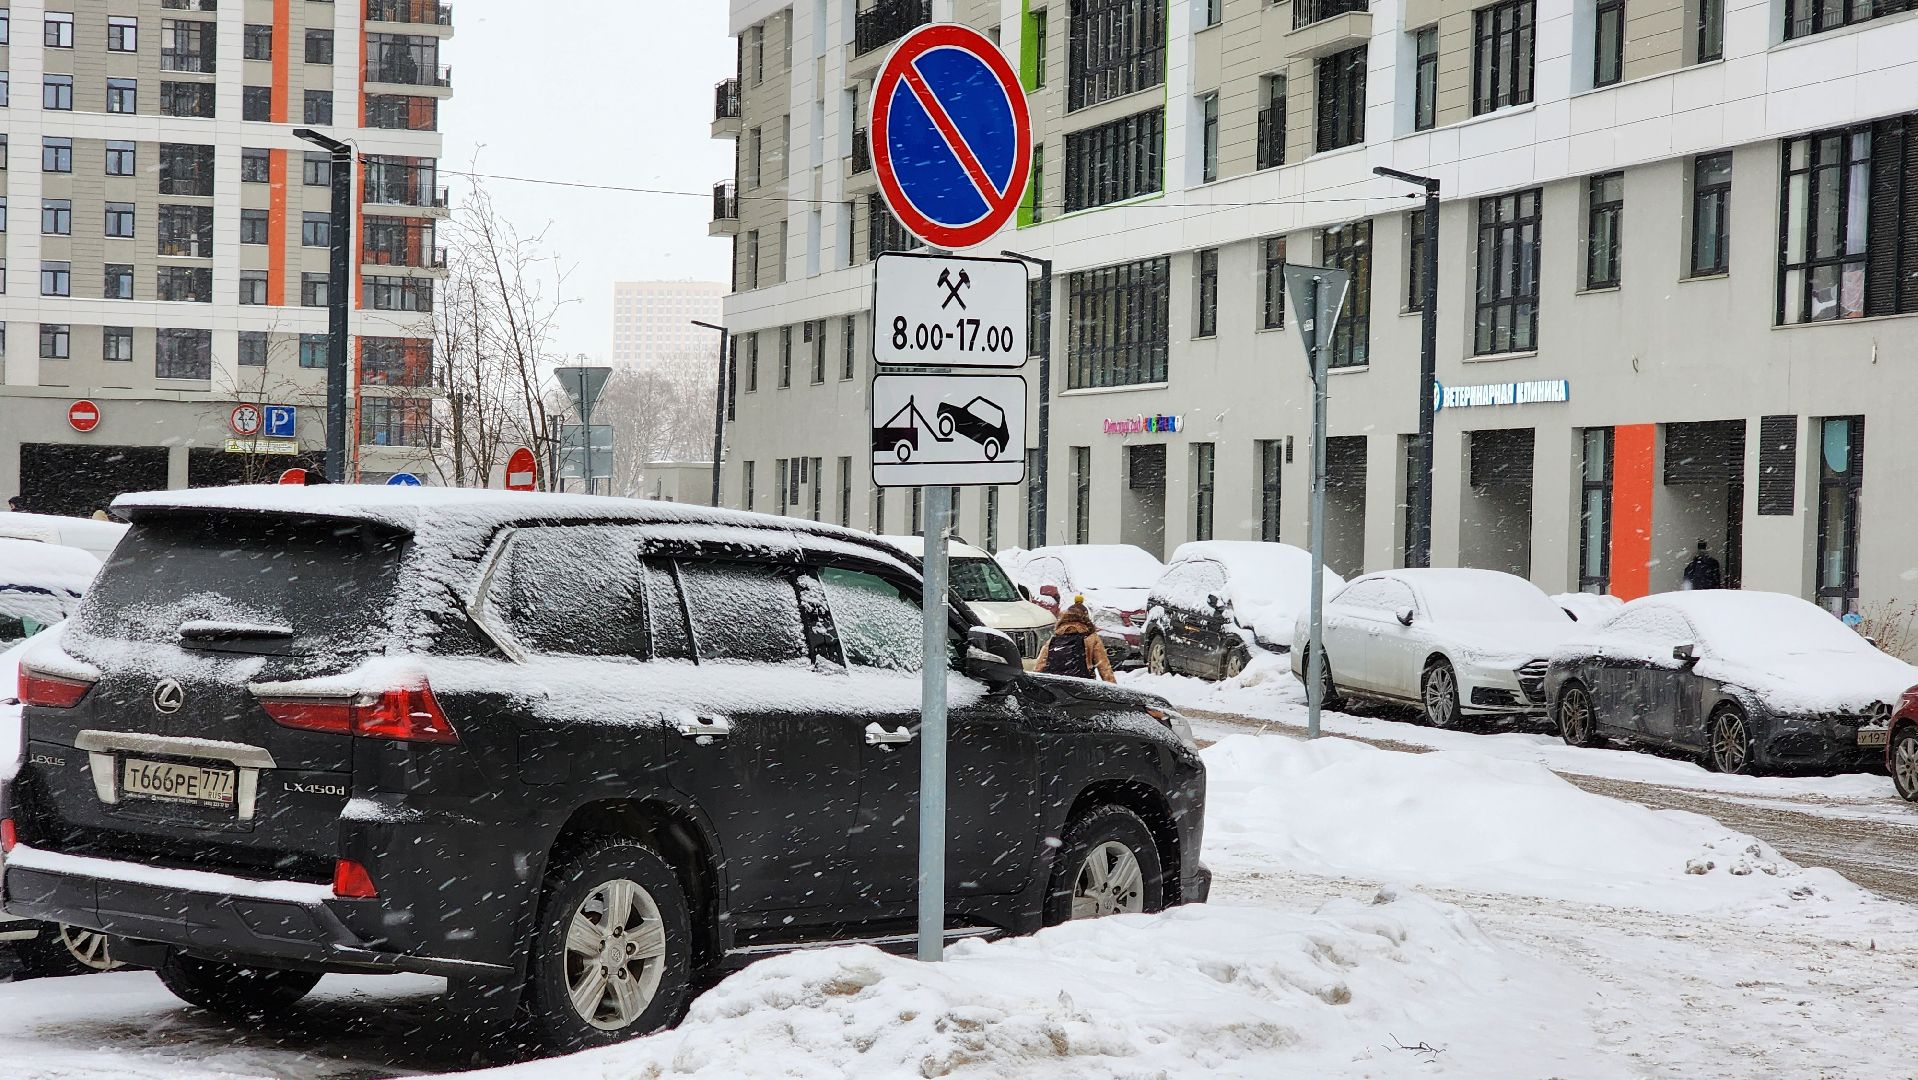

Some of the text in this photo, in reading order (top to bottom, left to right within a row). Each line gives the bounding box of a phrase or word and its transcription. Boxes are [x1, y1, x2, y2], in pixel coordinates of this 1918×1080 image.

[892, 315, 1014, 353] 8.00-17.00
[1443, 380, 1567, 407] ВЕТЕРИНАРНАЯ КЛИНИКА
[30, 753, 66, 766] LEXUS
[202, 770, 230, 793] 777
[283, 782, 345, 796] LX450d
[208, 791, 222, 800] RUS
